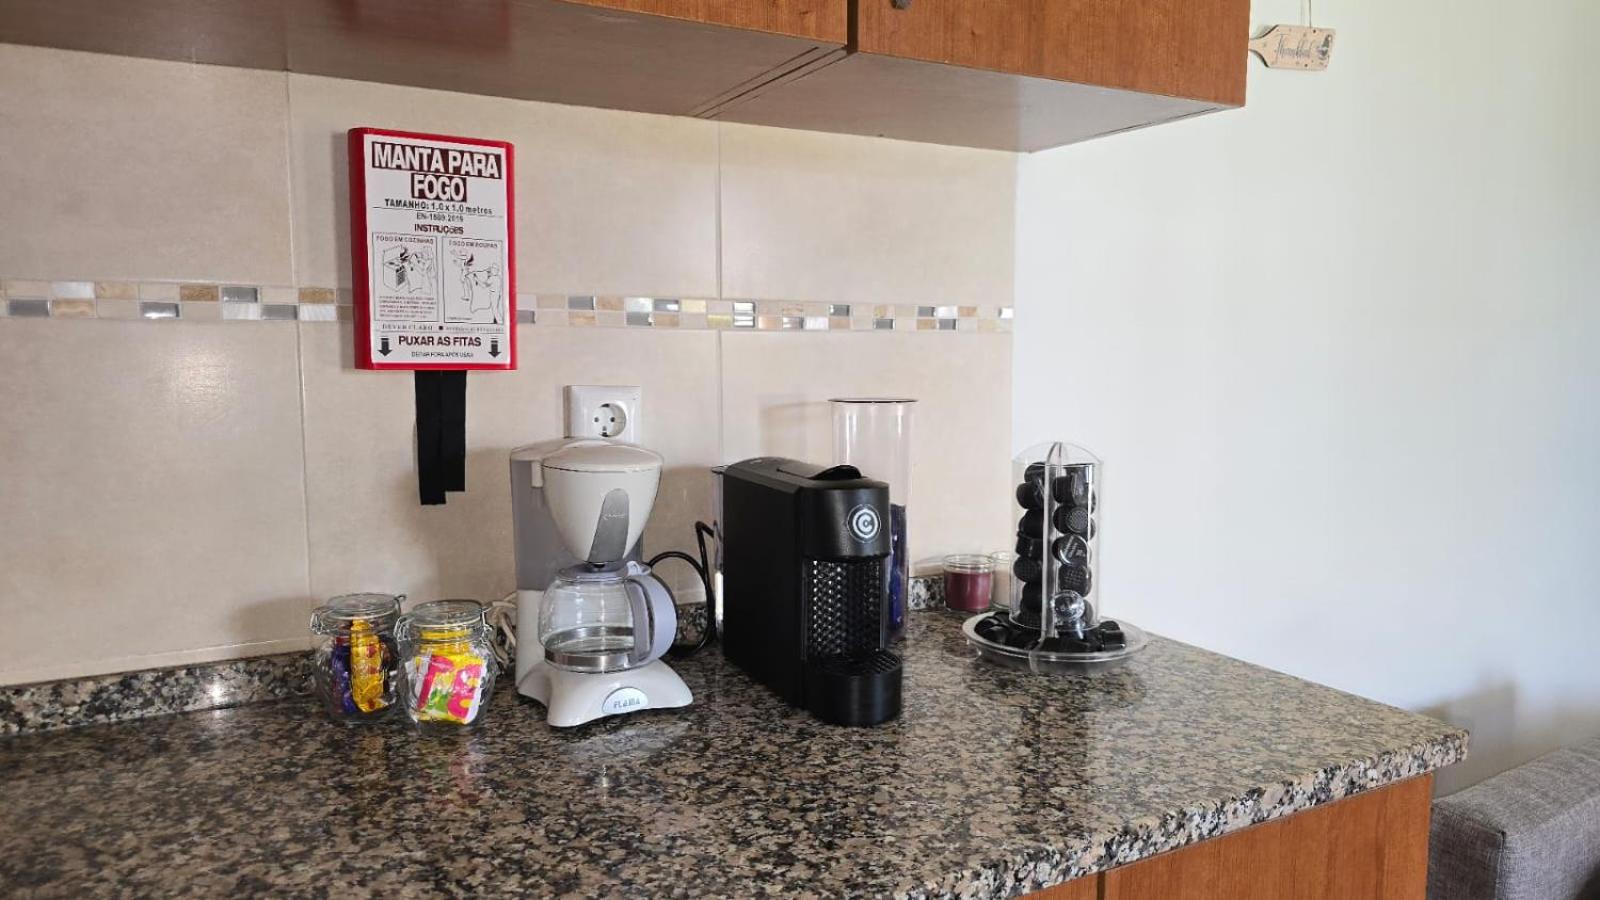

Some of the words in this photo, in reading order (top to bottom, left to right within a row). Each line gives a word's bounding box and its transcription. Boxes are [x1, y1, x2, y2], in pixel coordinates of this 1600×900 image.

[374, 144, 444, 173] MANTA
[448, 150, 499, 178] PARA
[413, 175, 464, 201] FOGO
[384, 198, 430, 210] TAMANHO:
[452, 204, 464, 212] 1.0
[465, 206, 493, 215] metros
[398, 335, 434, 346] PUXAR
[437, 336, 450, 345] AS
[453, 337, 482, 347] FITAS
